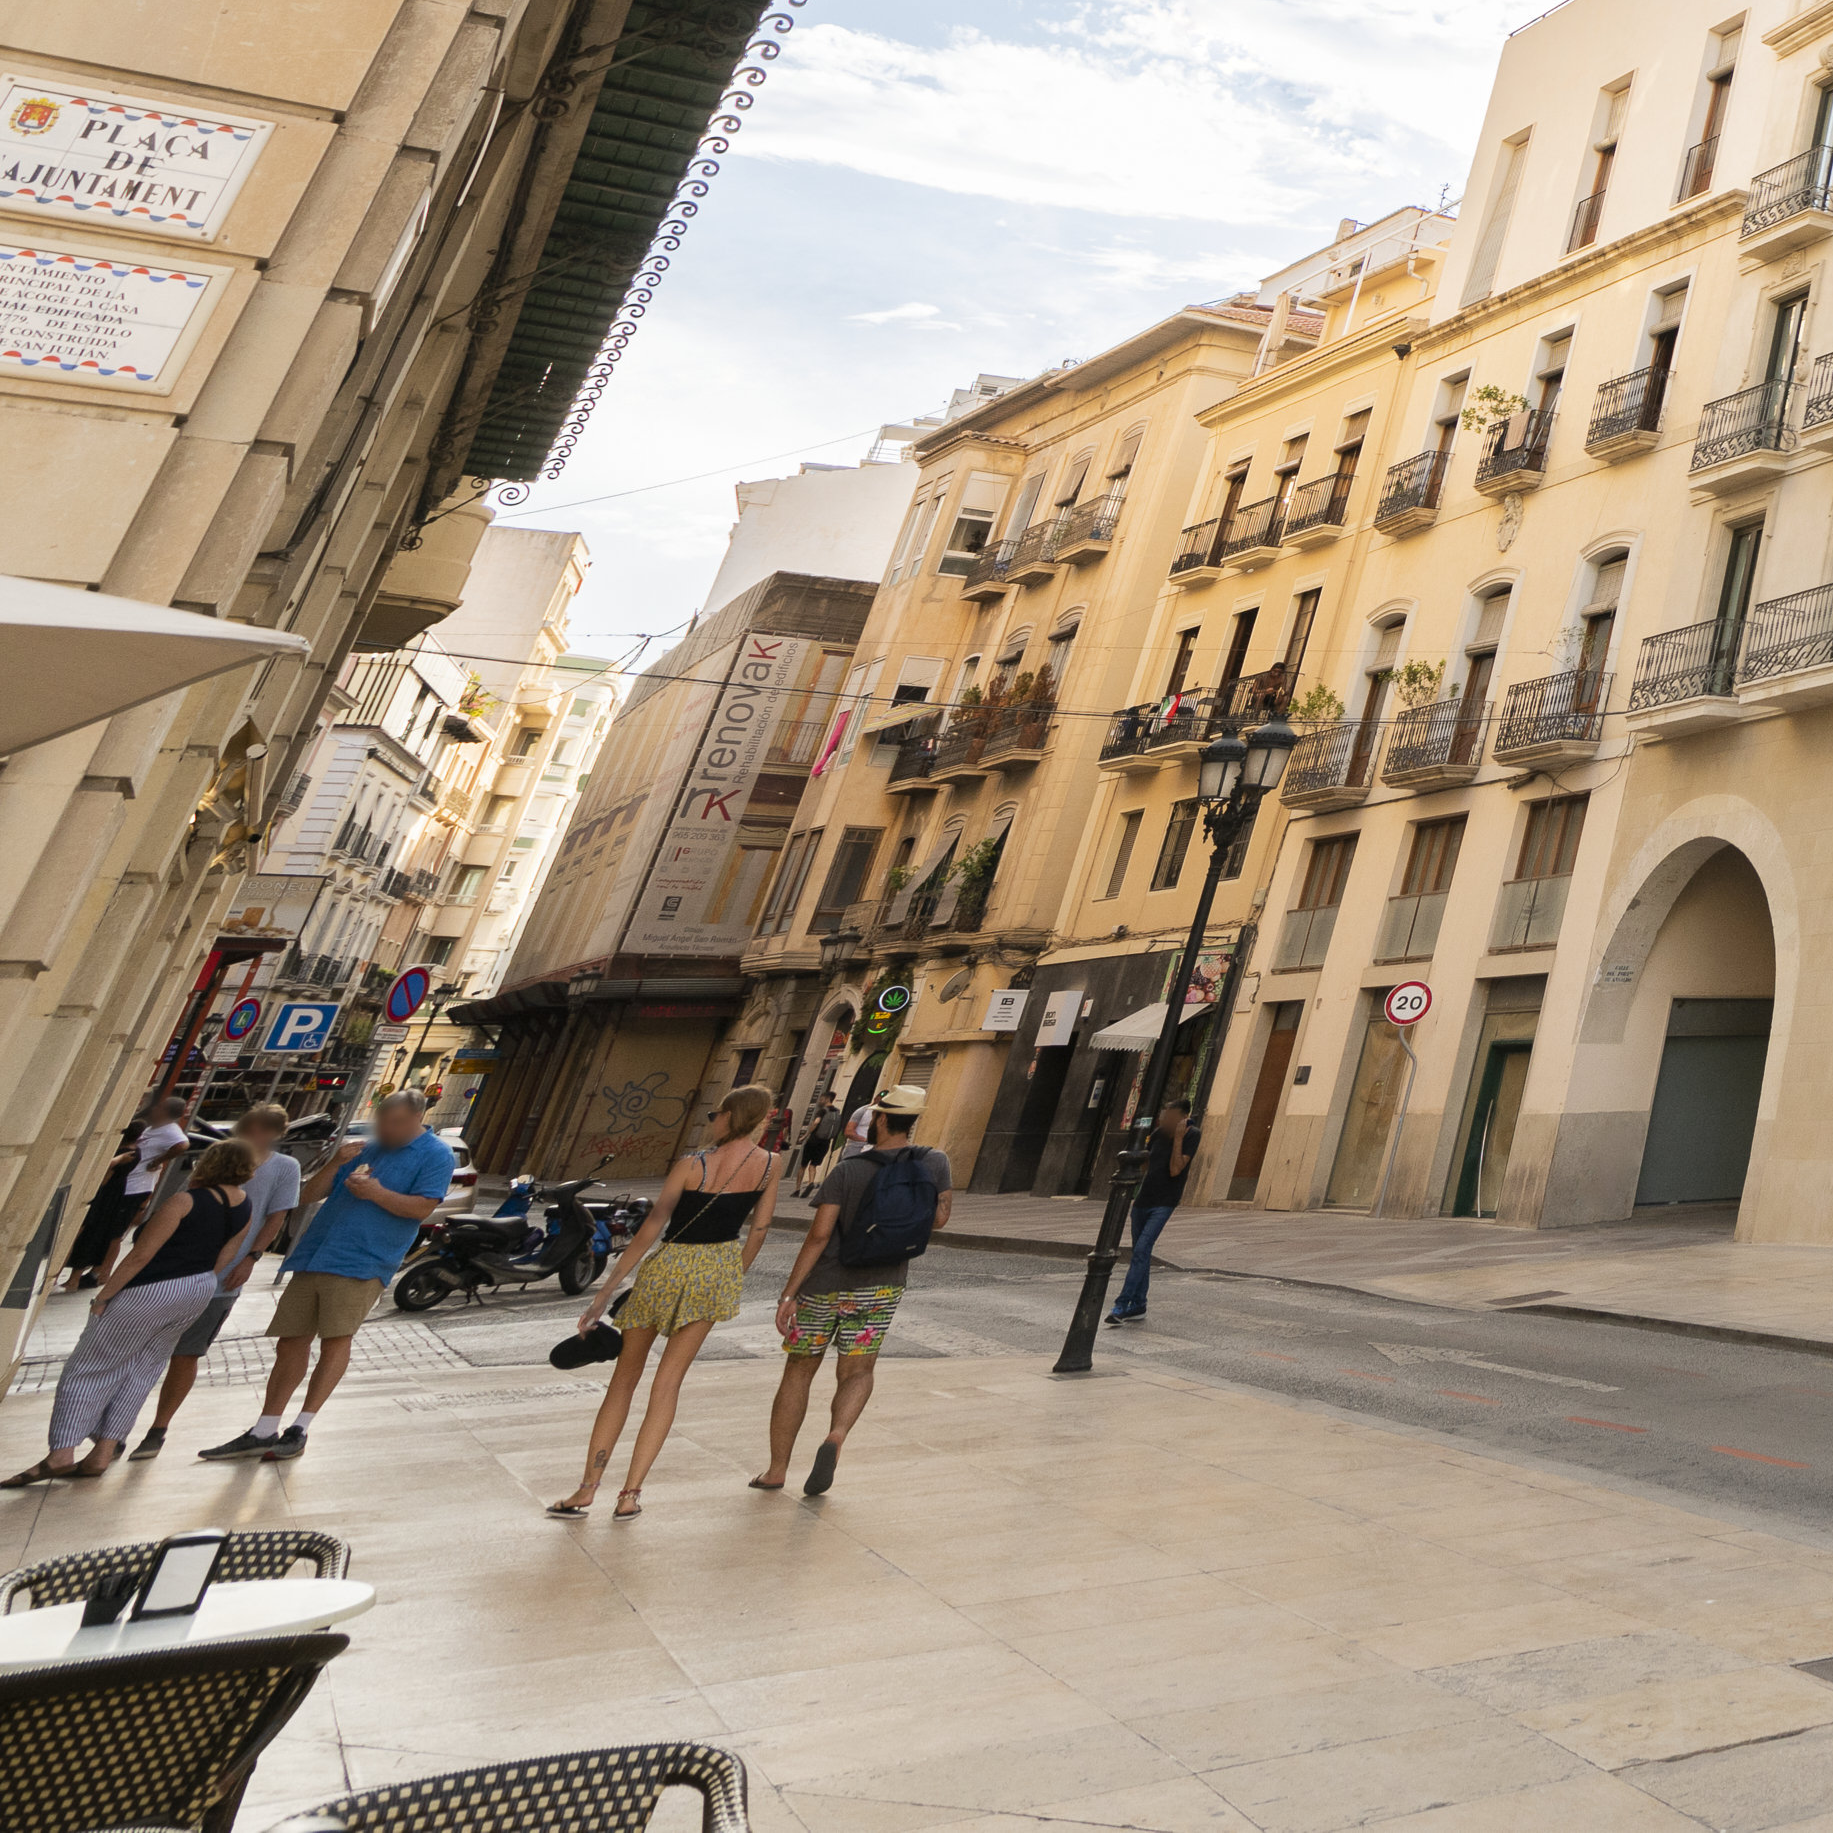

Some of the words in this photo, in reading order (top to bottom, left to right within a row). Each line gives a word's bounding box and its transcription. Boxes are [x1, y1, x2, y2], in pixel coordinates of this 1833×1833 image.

[80, 119, 210, 161] PLAÇA
[102, 150, 164, 179] DE
[2, 262, 106, 285] NTAMIENTO
[13, 290, 70, 304] ACOGE
[73, 298, 93, 309] LA
[98, 302, 138, 315] CASA
[79, 286, 103, 297] DE
[104, 290, 125, 301] LA
[34, 305, 123, 325] EDIFICADA
[10, 327, 117, 349] CONSTRUIDA
[46, 319, 70, 330] DE
[72, 323, 132, 339] ESTILO
[12, 339, 45, 351] SAN
[732, 705, 773, 784] Rehabilitación
[774, 642, 799, 687] edificios
[1395, 995, 1423, 1010] 20
[277, 1008, 323, 1046] P
